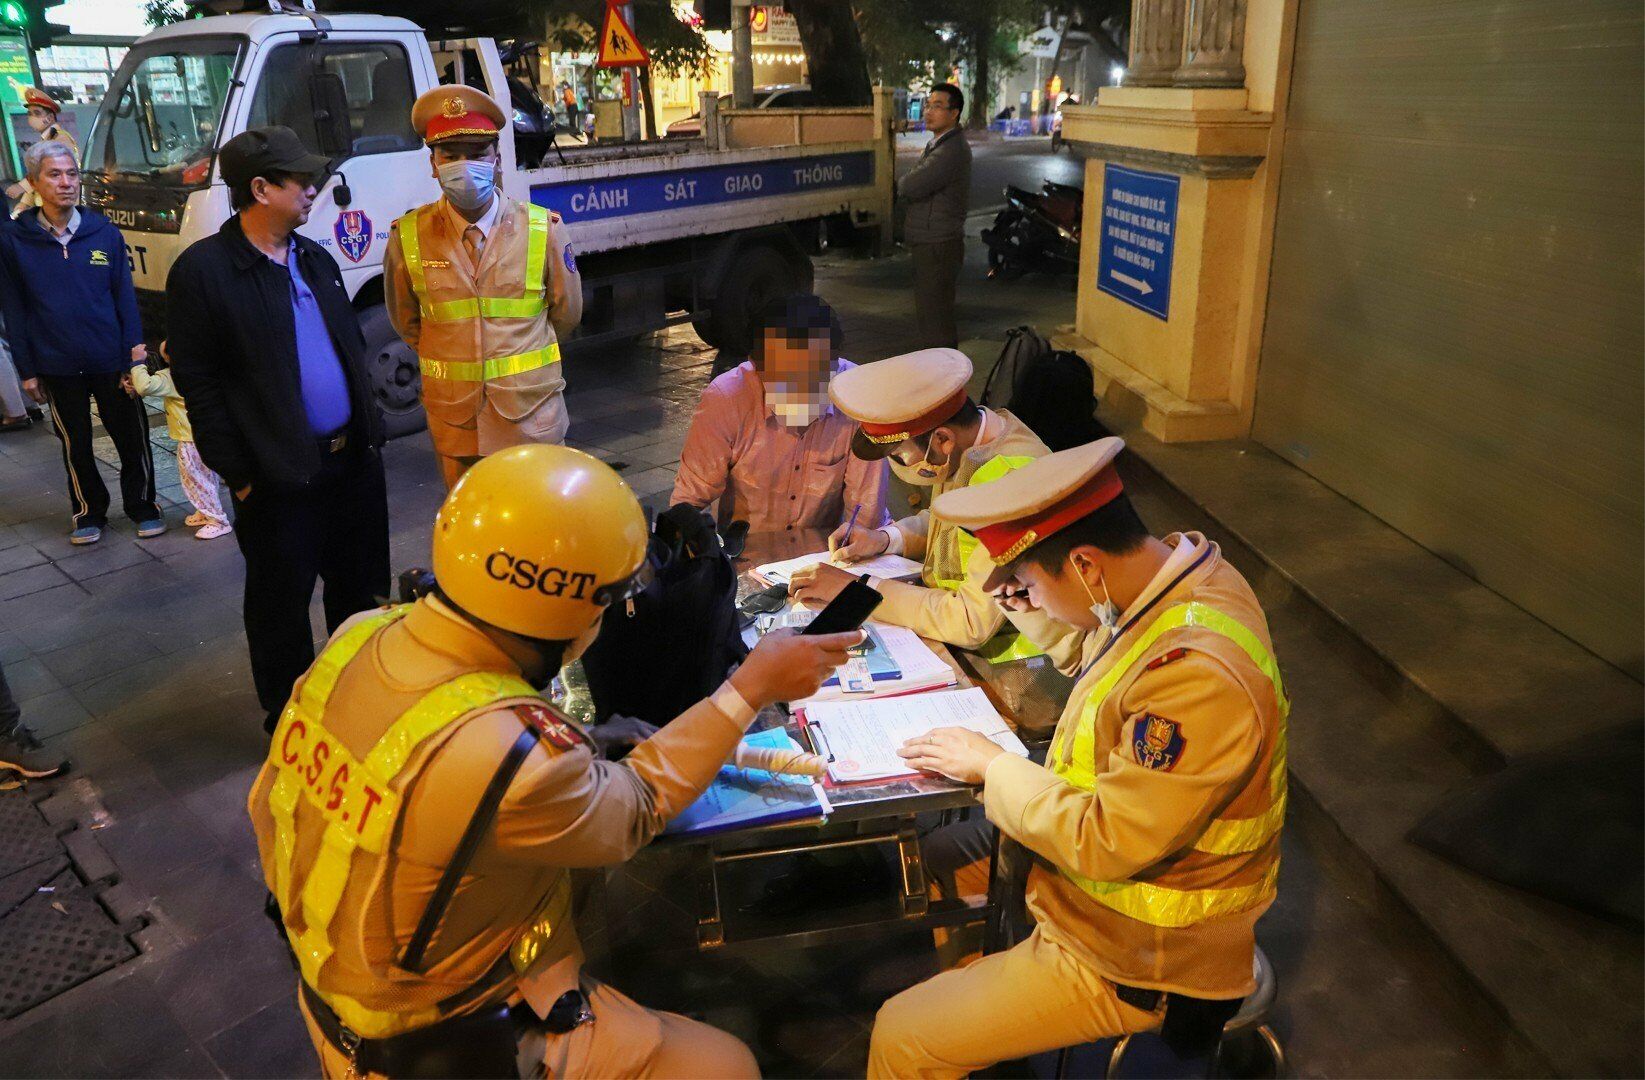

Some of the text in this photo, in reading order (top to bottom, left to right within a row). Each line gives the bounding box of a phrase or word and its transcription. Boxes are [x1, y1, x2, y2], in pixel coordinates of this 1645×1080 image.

[571, 163, 843, 213] CẢNH SÁT GIAO THÔNG
[341, 234, 368, 244] CSGT
[485, 551, 597, 600] CSGT
[1135, 740, 1173, 763] CSGT
